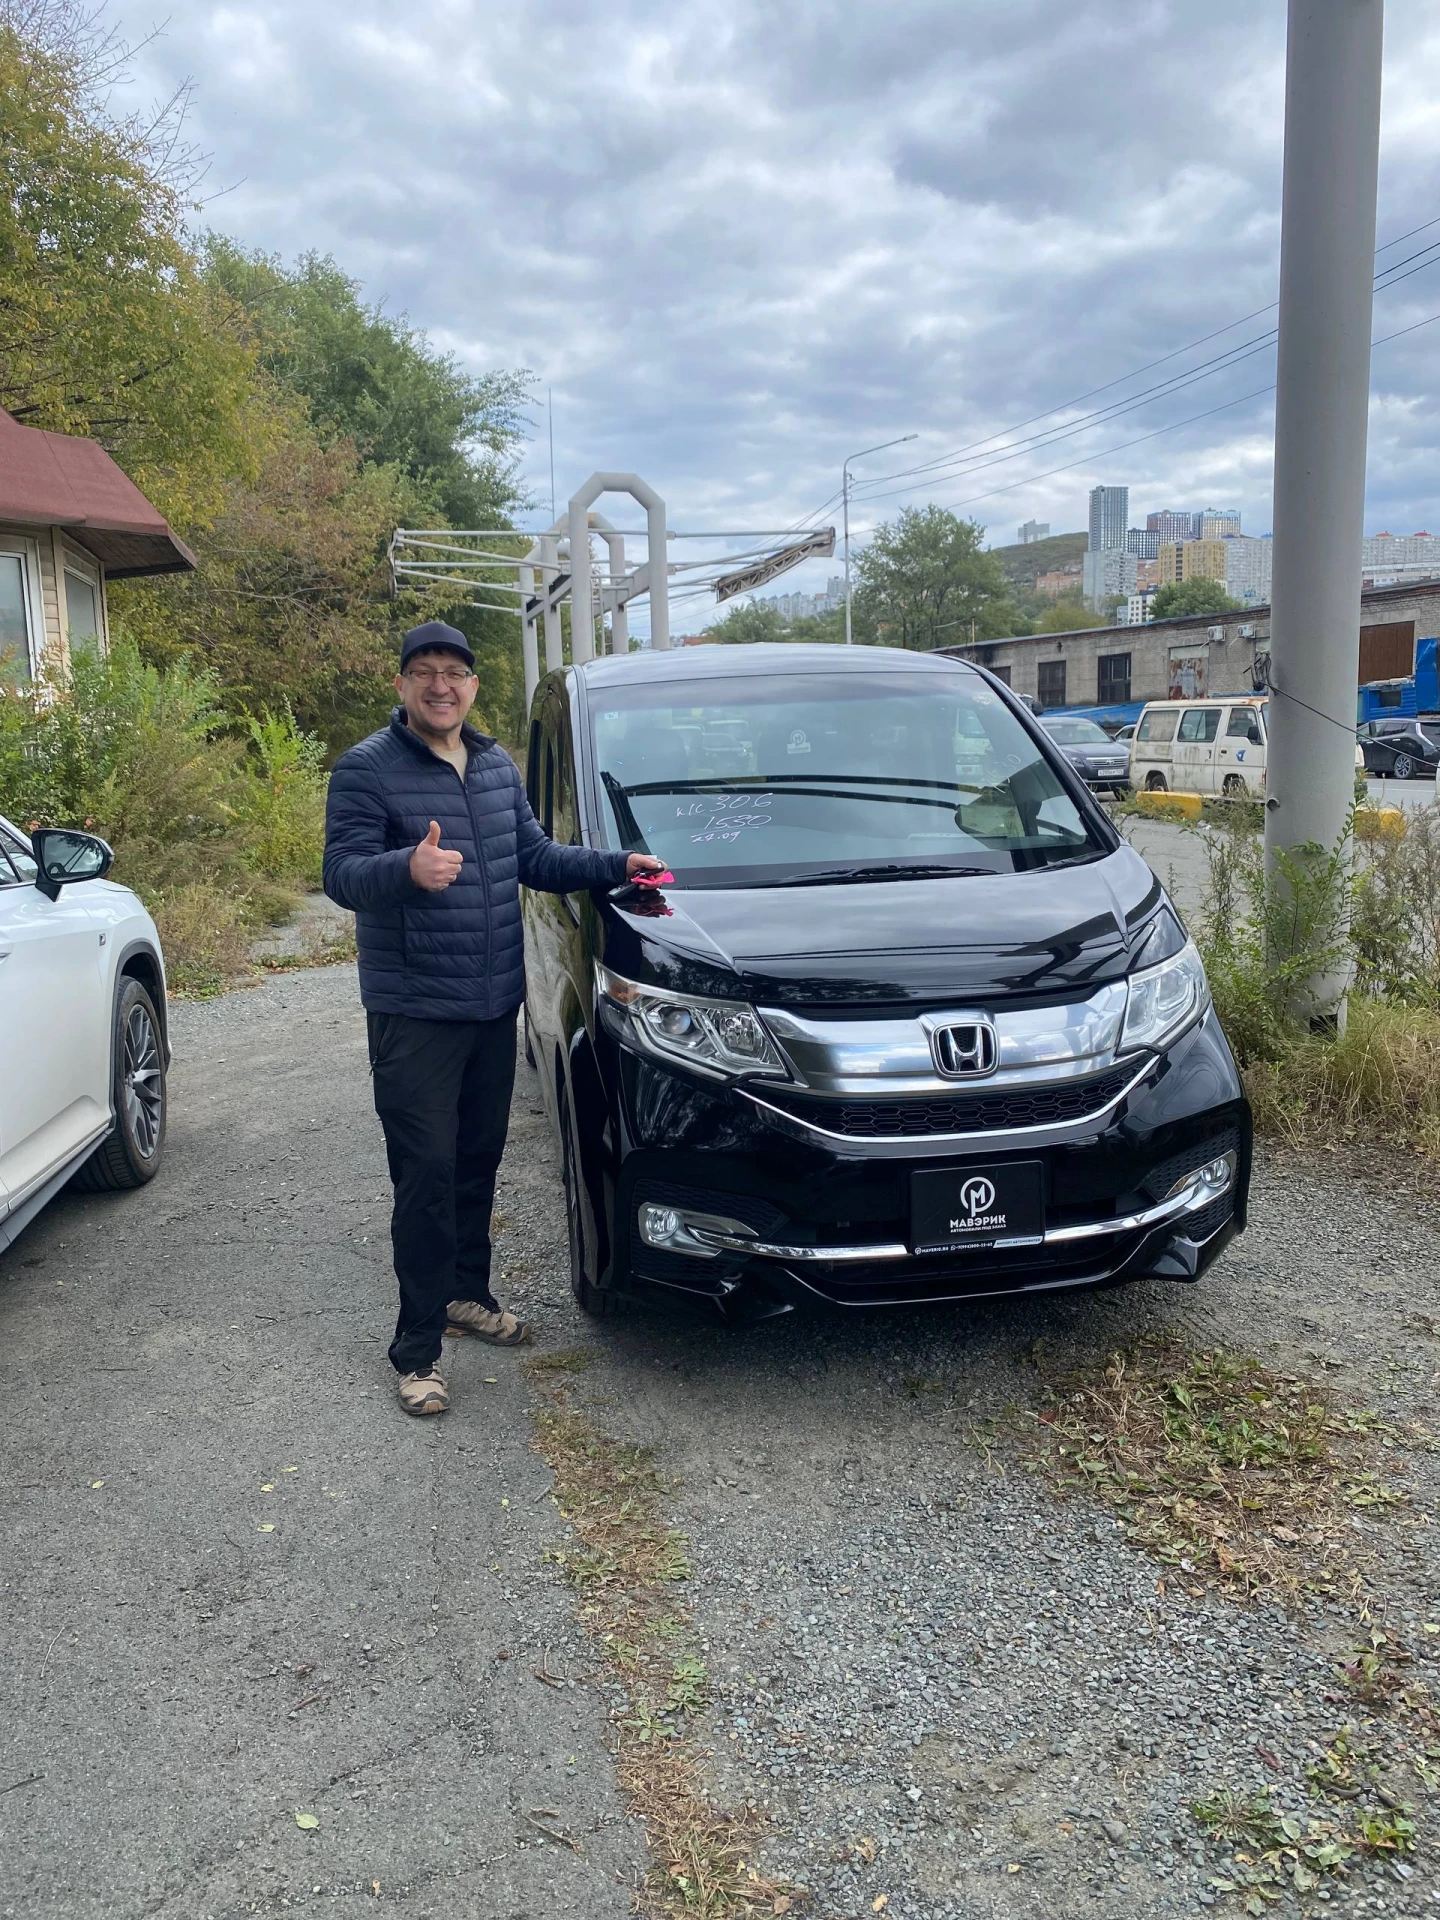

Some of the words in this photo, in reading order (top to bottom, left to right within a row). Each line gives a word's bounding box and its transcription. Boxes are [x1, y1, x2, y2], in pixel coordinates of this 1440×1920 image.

[709, 792, 774, 813] 306
[704, 814, 772, 830] 1530
[950, 1215, 1006, 1228] МАВЭРИК
